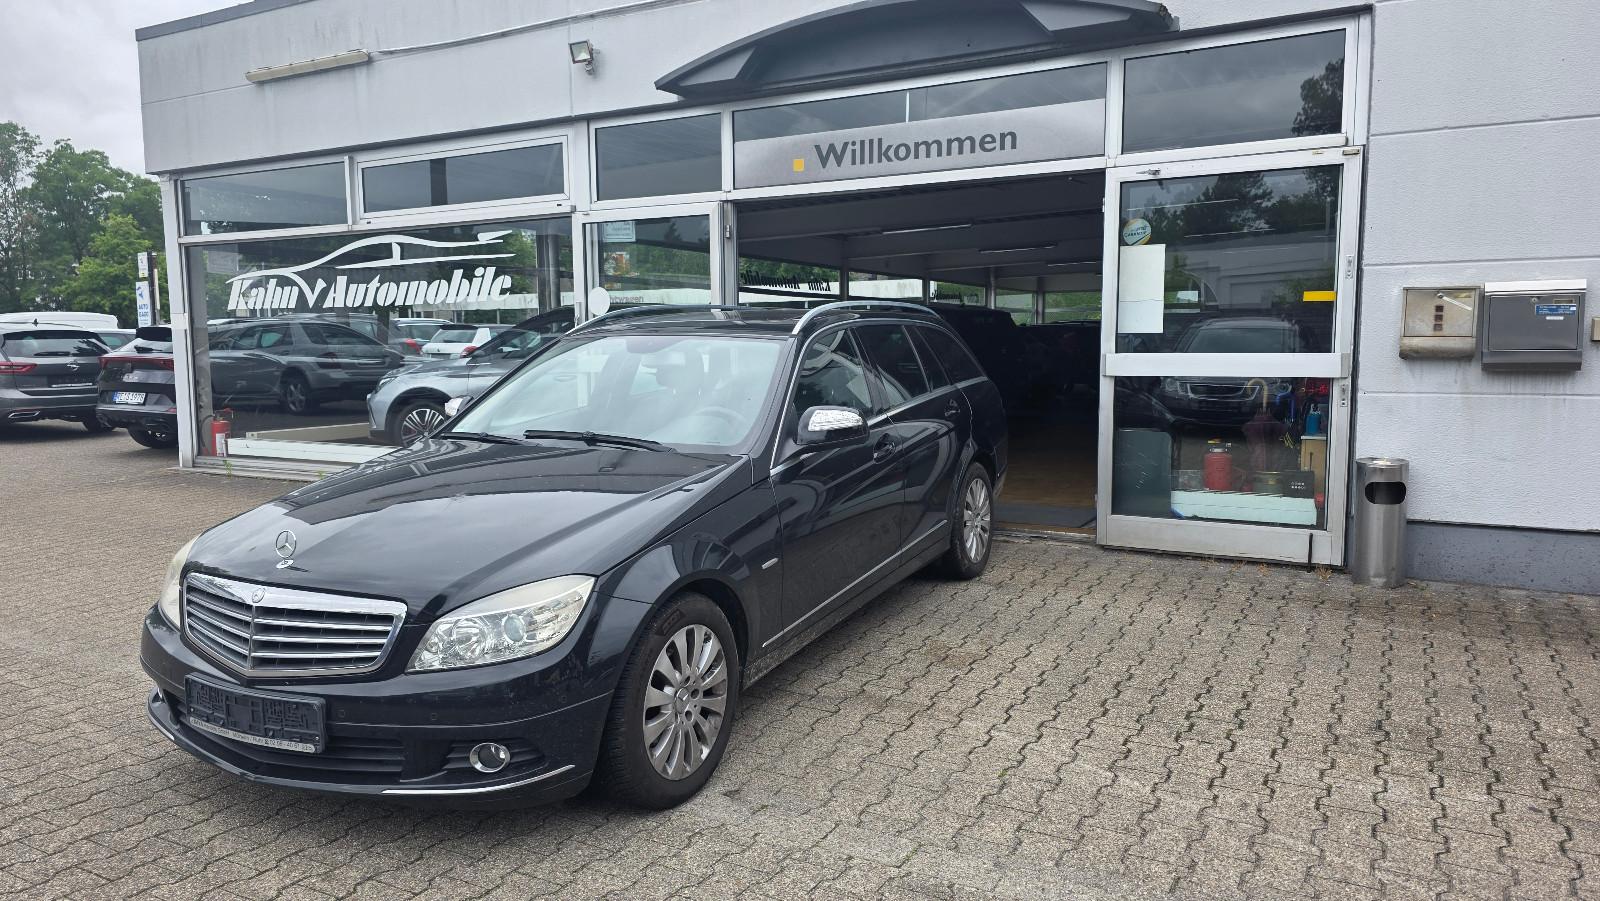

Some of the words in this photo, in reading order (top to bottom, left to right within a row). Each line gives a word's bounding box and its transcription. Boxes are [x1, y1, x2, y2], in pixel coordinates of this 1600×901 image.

[814, 130, 1018, 169] Willkommen
[227, 279, 299, 310] Kahn
[323, 266, 512, 309] Automobile
